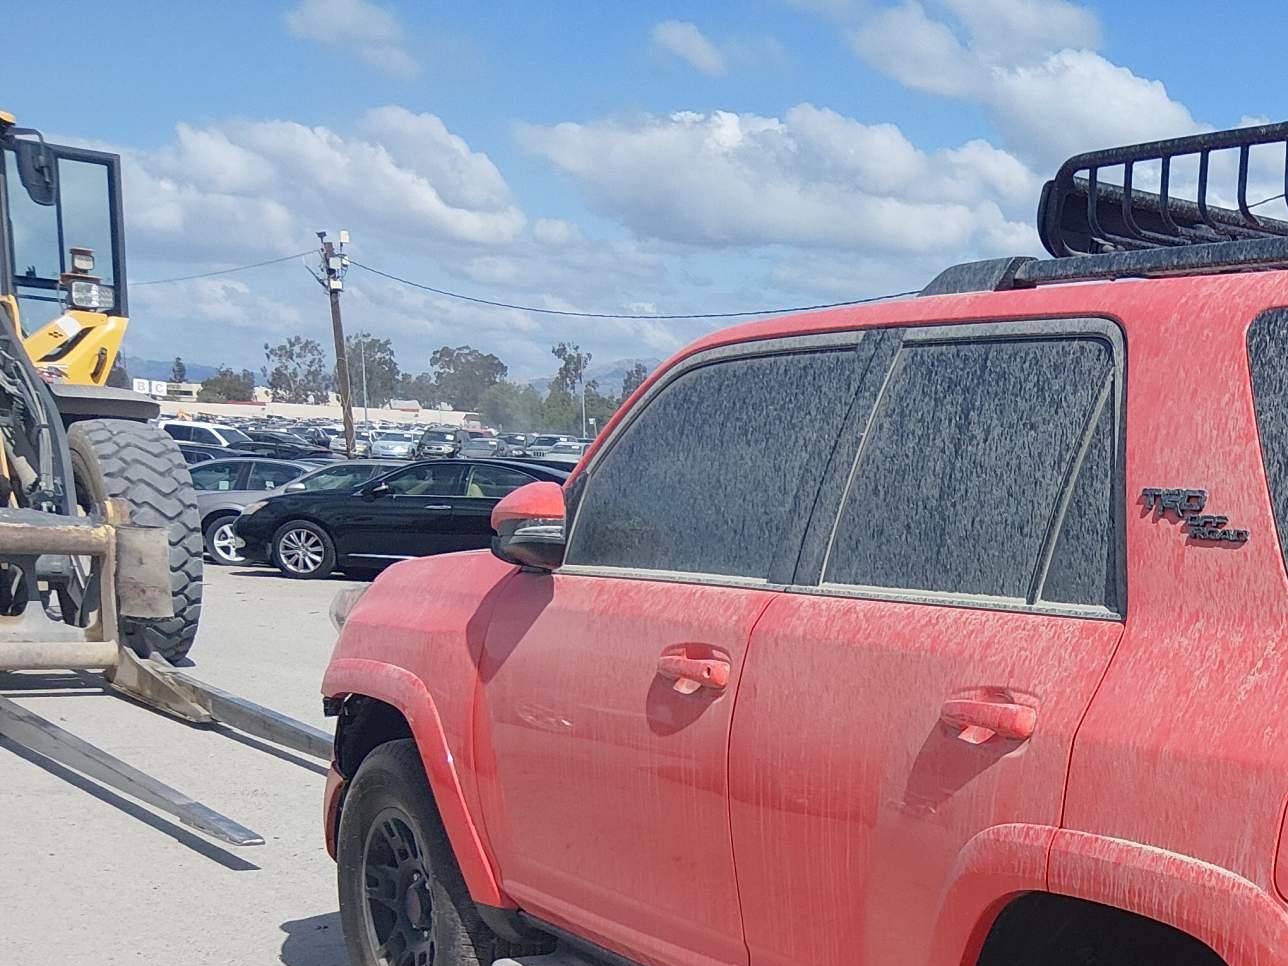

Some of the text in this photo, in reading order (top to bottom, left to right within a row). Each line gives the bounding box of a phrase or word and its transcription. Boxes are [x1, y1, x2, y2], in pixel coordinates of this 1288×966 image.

[1142, 488, 1207, 517] TRD
[1187, 515, 1229, 528] OFF
[1189, 527, 1250, 542] ROAD
